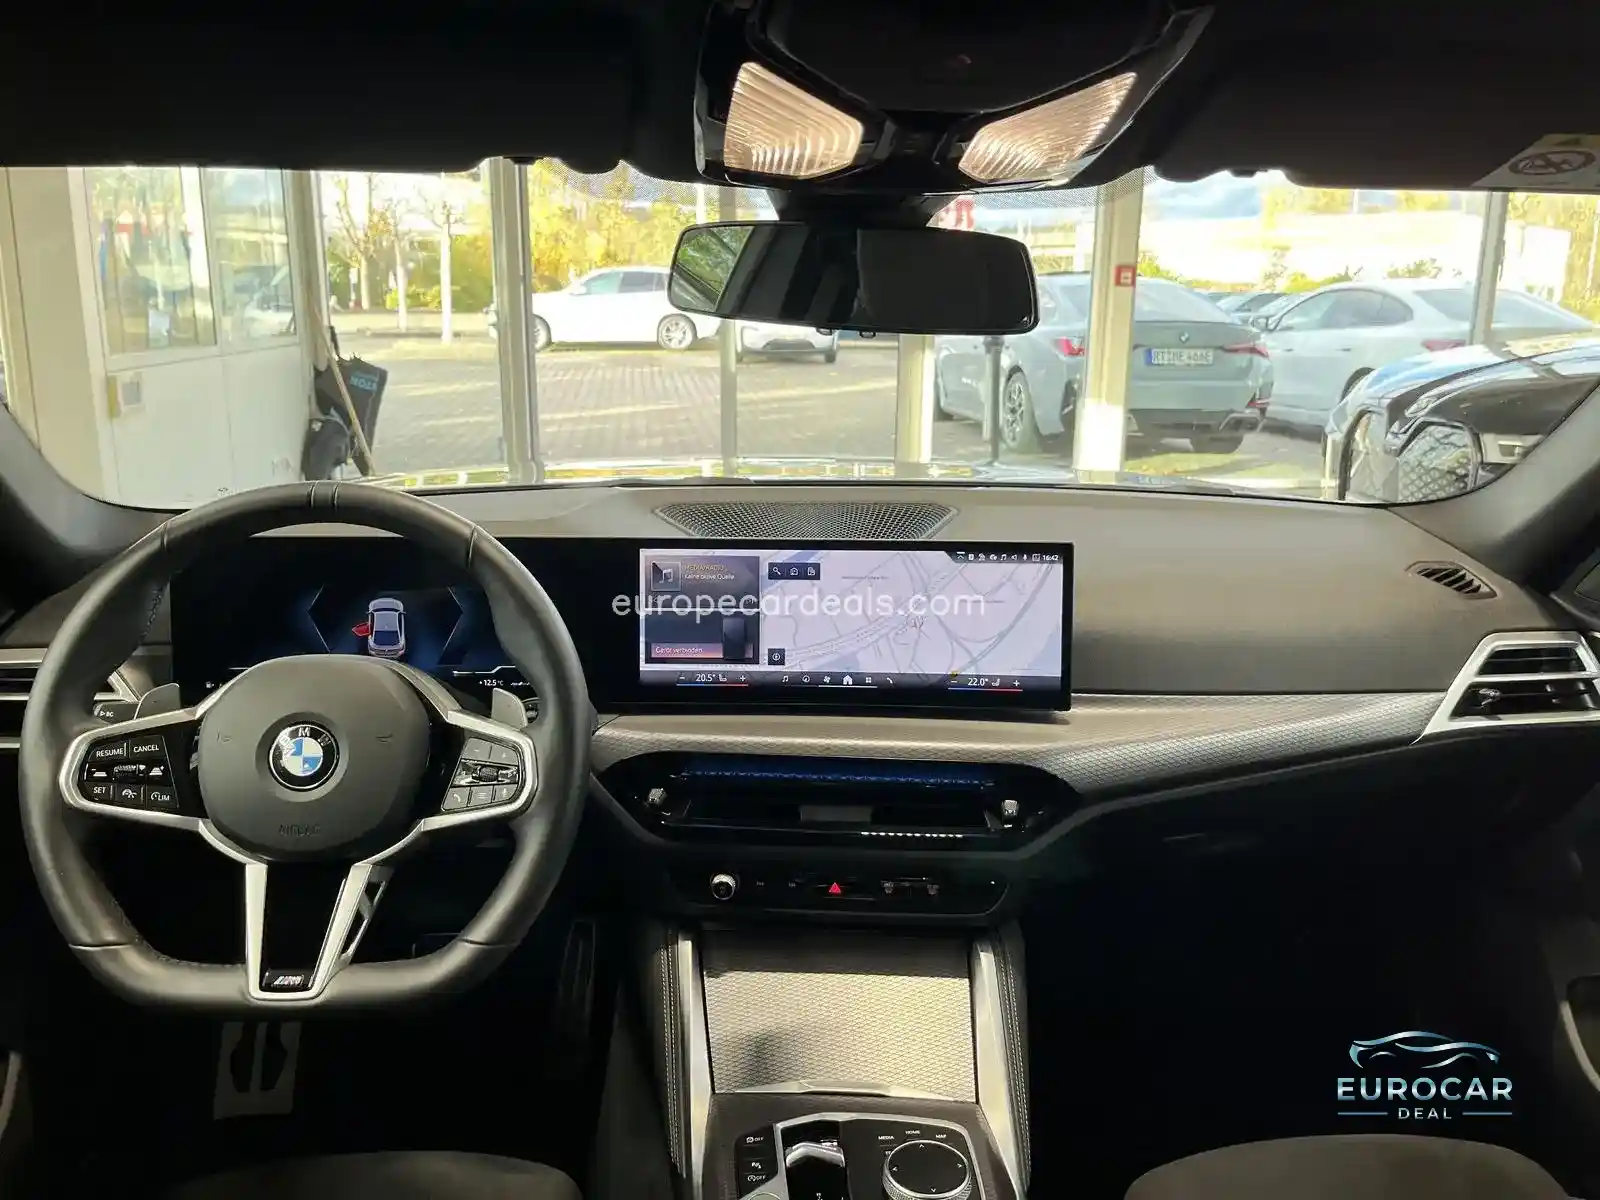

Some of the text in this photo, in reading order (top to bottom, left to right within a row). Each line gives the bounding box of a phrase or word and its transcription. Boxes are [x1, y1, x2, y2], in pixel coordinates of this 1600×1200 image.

[1042, 554, 1059, 562] 16:42
[96, 747, 123, 758] RESUME
[133, 744, 160, 753] CANCEL
[93, 786, 107, 794] SET
